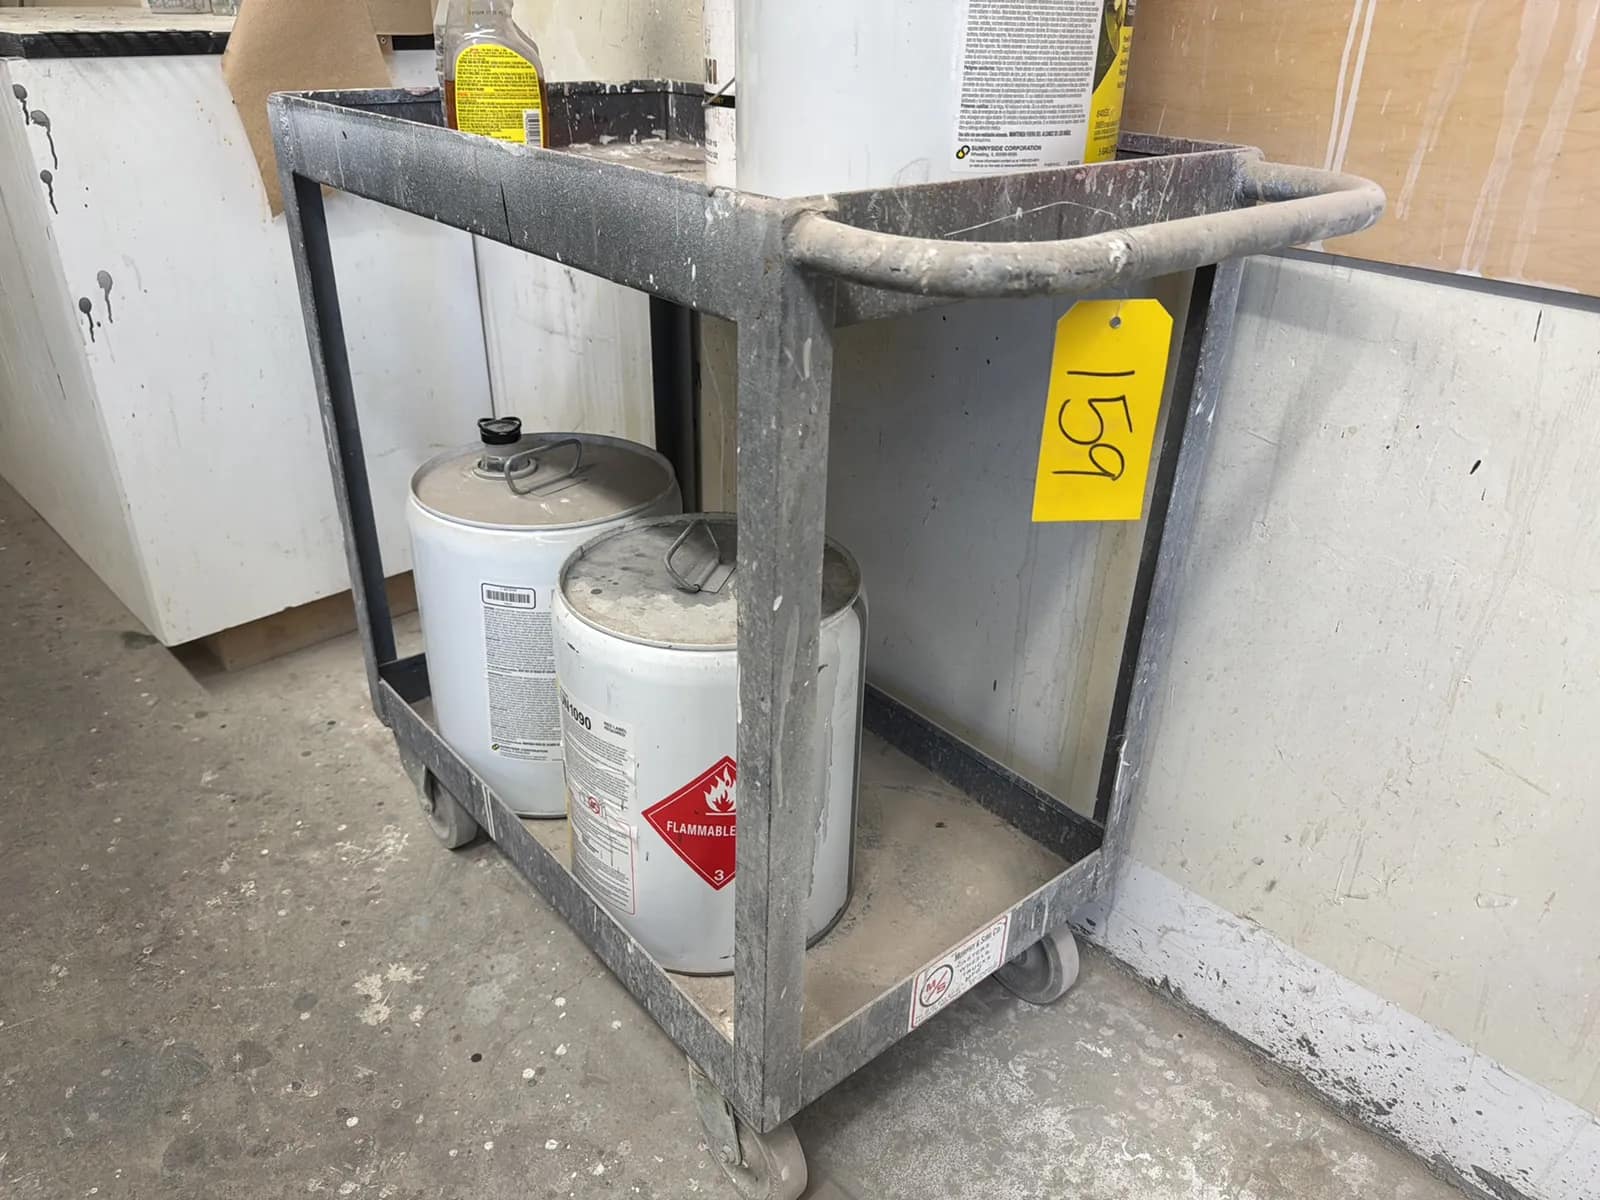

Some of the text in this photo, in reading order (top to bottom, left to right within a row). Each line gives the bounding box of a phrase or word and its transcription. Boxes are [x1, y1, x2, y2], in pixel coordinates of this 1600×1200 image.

[1052, 370, 1135, 481] 159
[666, 820, 737, 837] FLAMMABLE
[714, 868, 725, 881] 3
